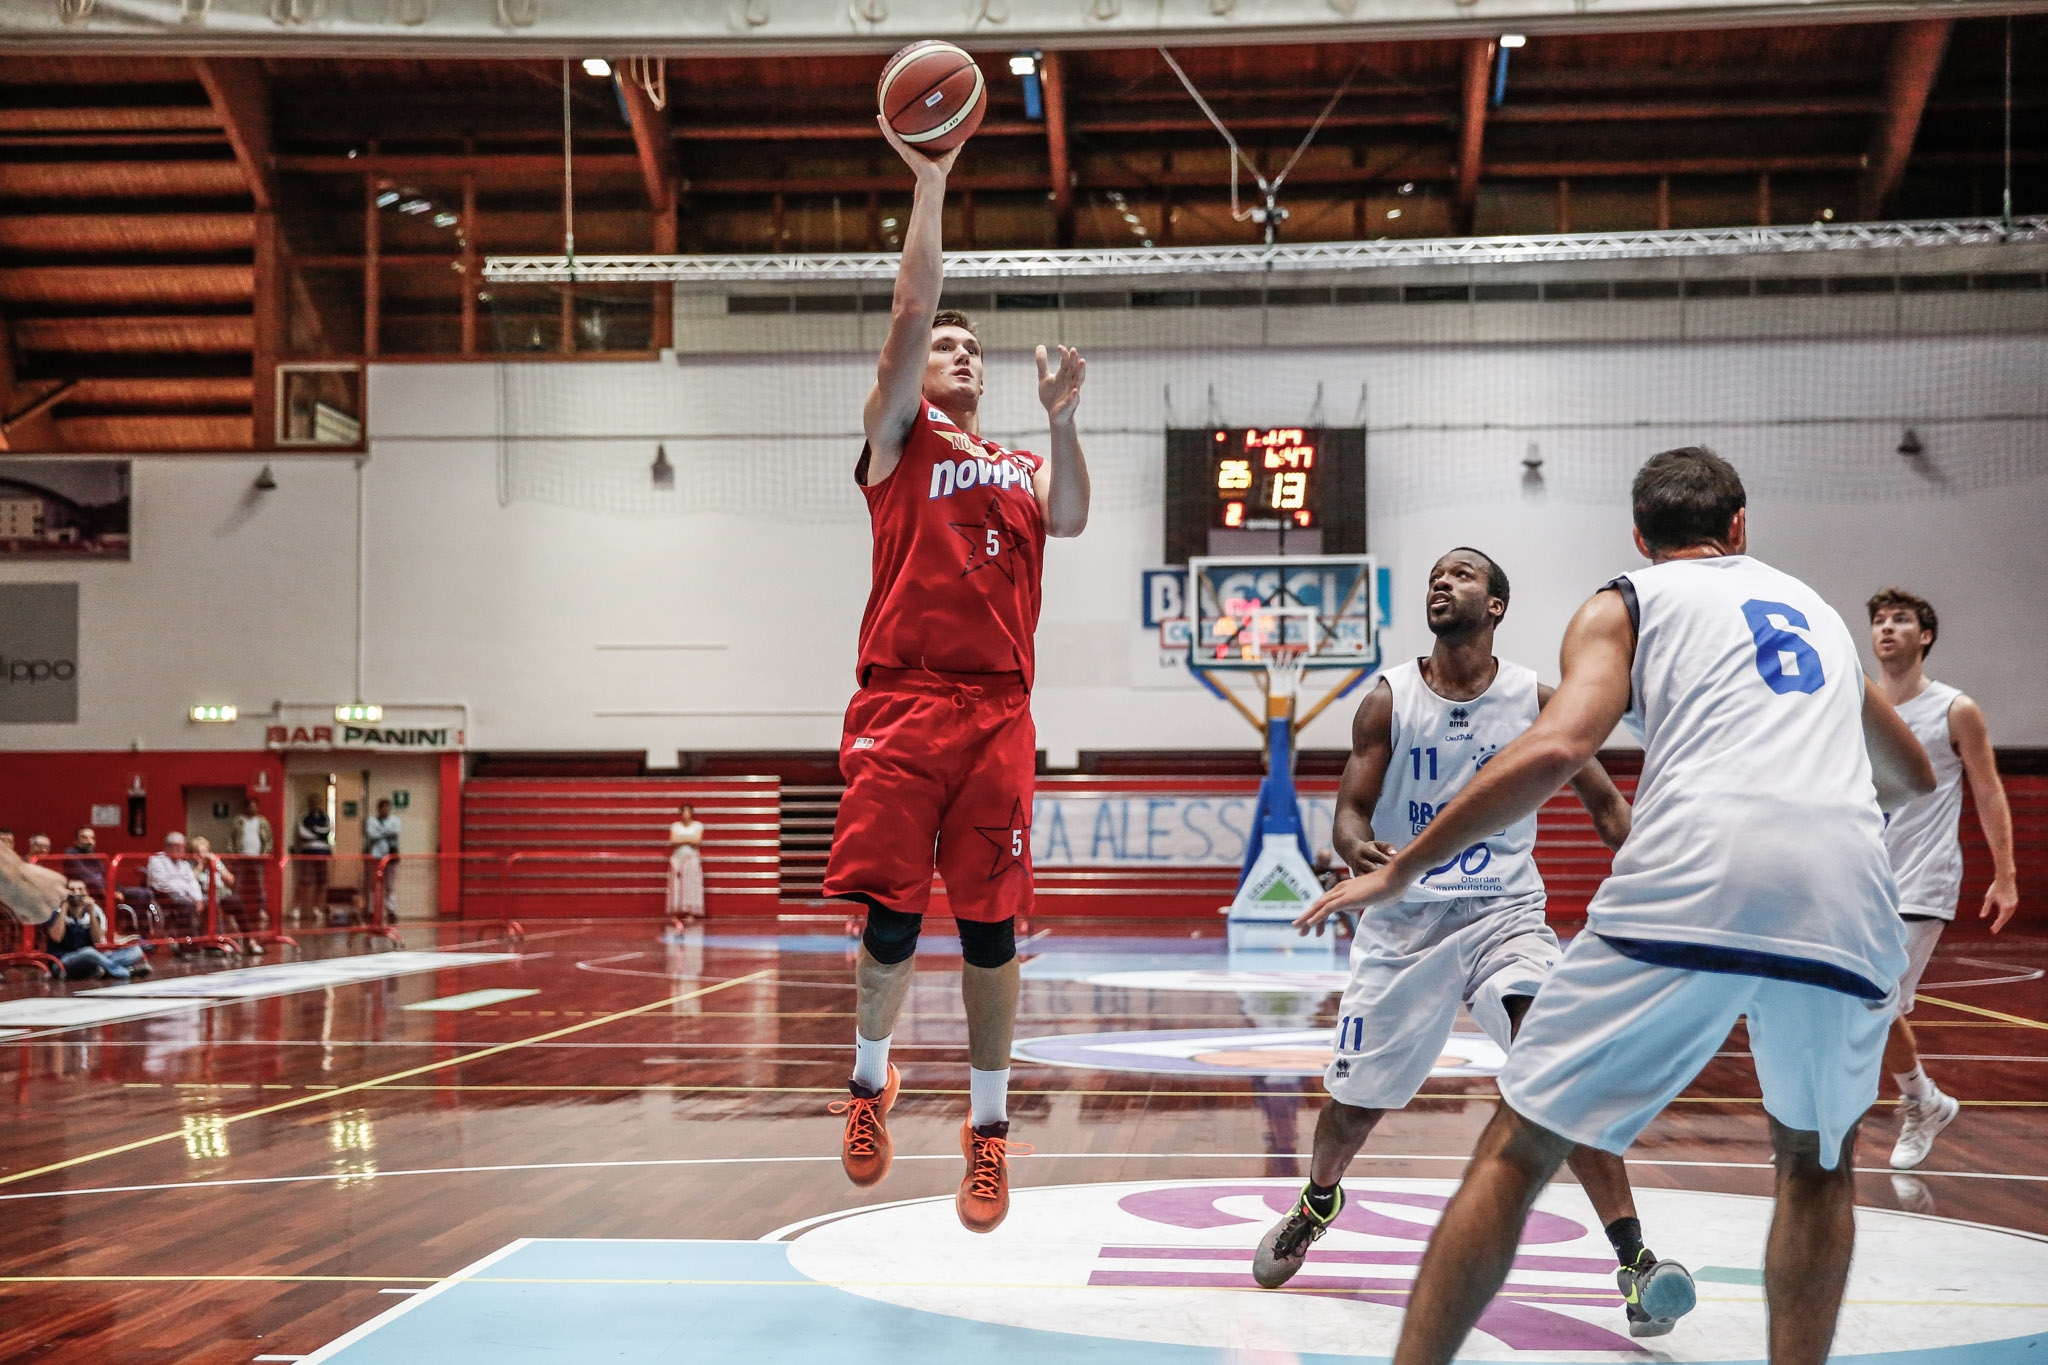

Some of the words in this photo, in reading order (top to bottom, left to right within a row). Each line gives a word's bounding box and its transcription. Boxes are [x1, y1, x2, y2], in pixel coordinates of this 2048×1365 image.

[1271, 472, 1307, 509] 13
[986, 529, 999, 556] 5
[1740, 598, 1825, 695] 6
[268, 726, 333, 743] BAR
[344, 727, 448, 745] PANINI
[1410, 747, 1437, 780] 11
[1011, 829, 1022, 857] 5
[1340, 1016, 1364, 1051] 11
